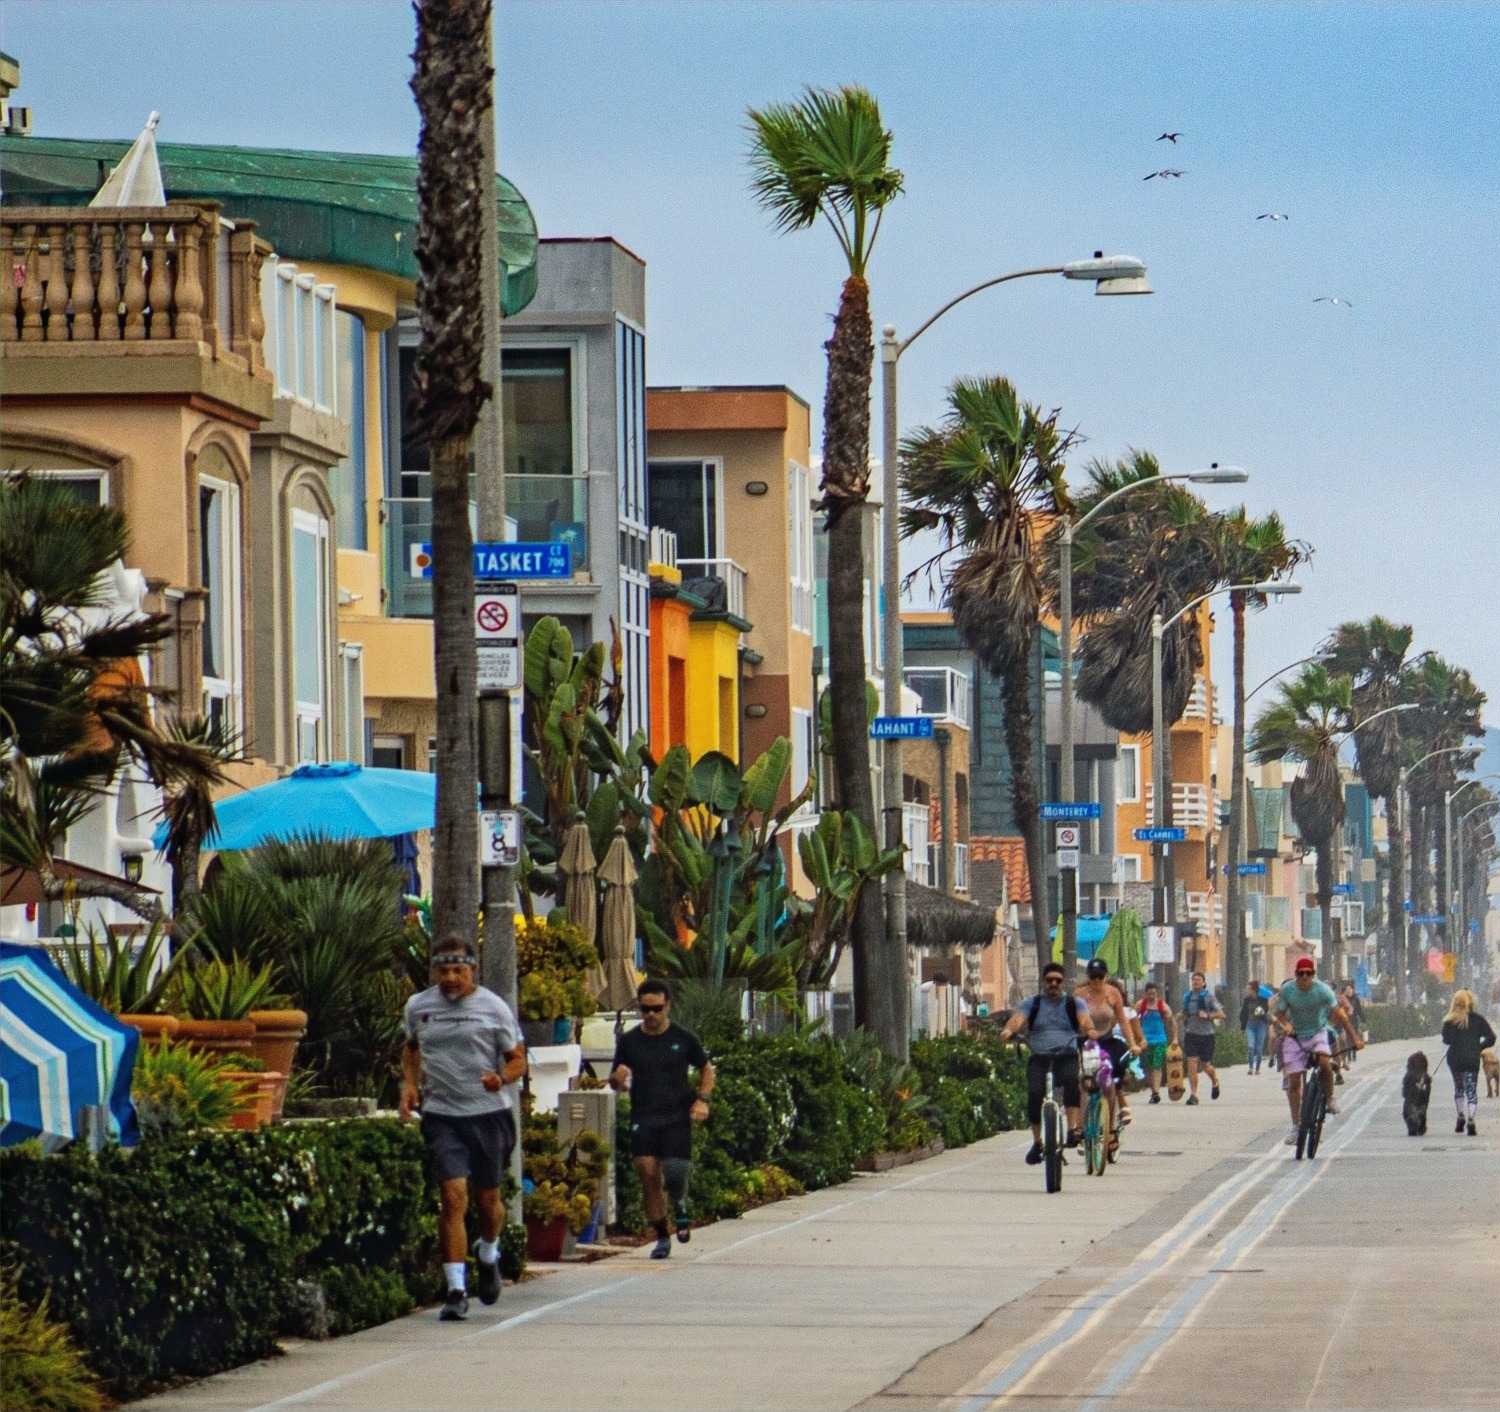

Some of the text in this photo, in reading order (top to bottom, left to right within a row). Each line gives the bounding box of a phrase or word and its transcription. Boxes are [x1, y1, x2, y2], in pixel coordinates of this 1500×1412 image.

[477, 552, 543, 572] TASKET
[1043, 806, 1088, 817] MONTEREY
[492, 831, 506, 852] 8
